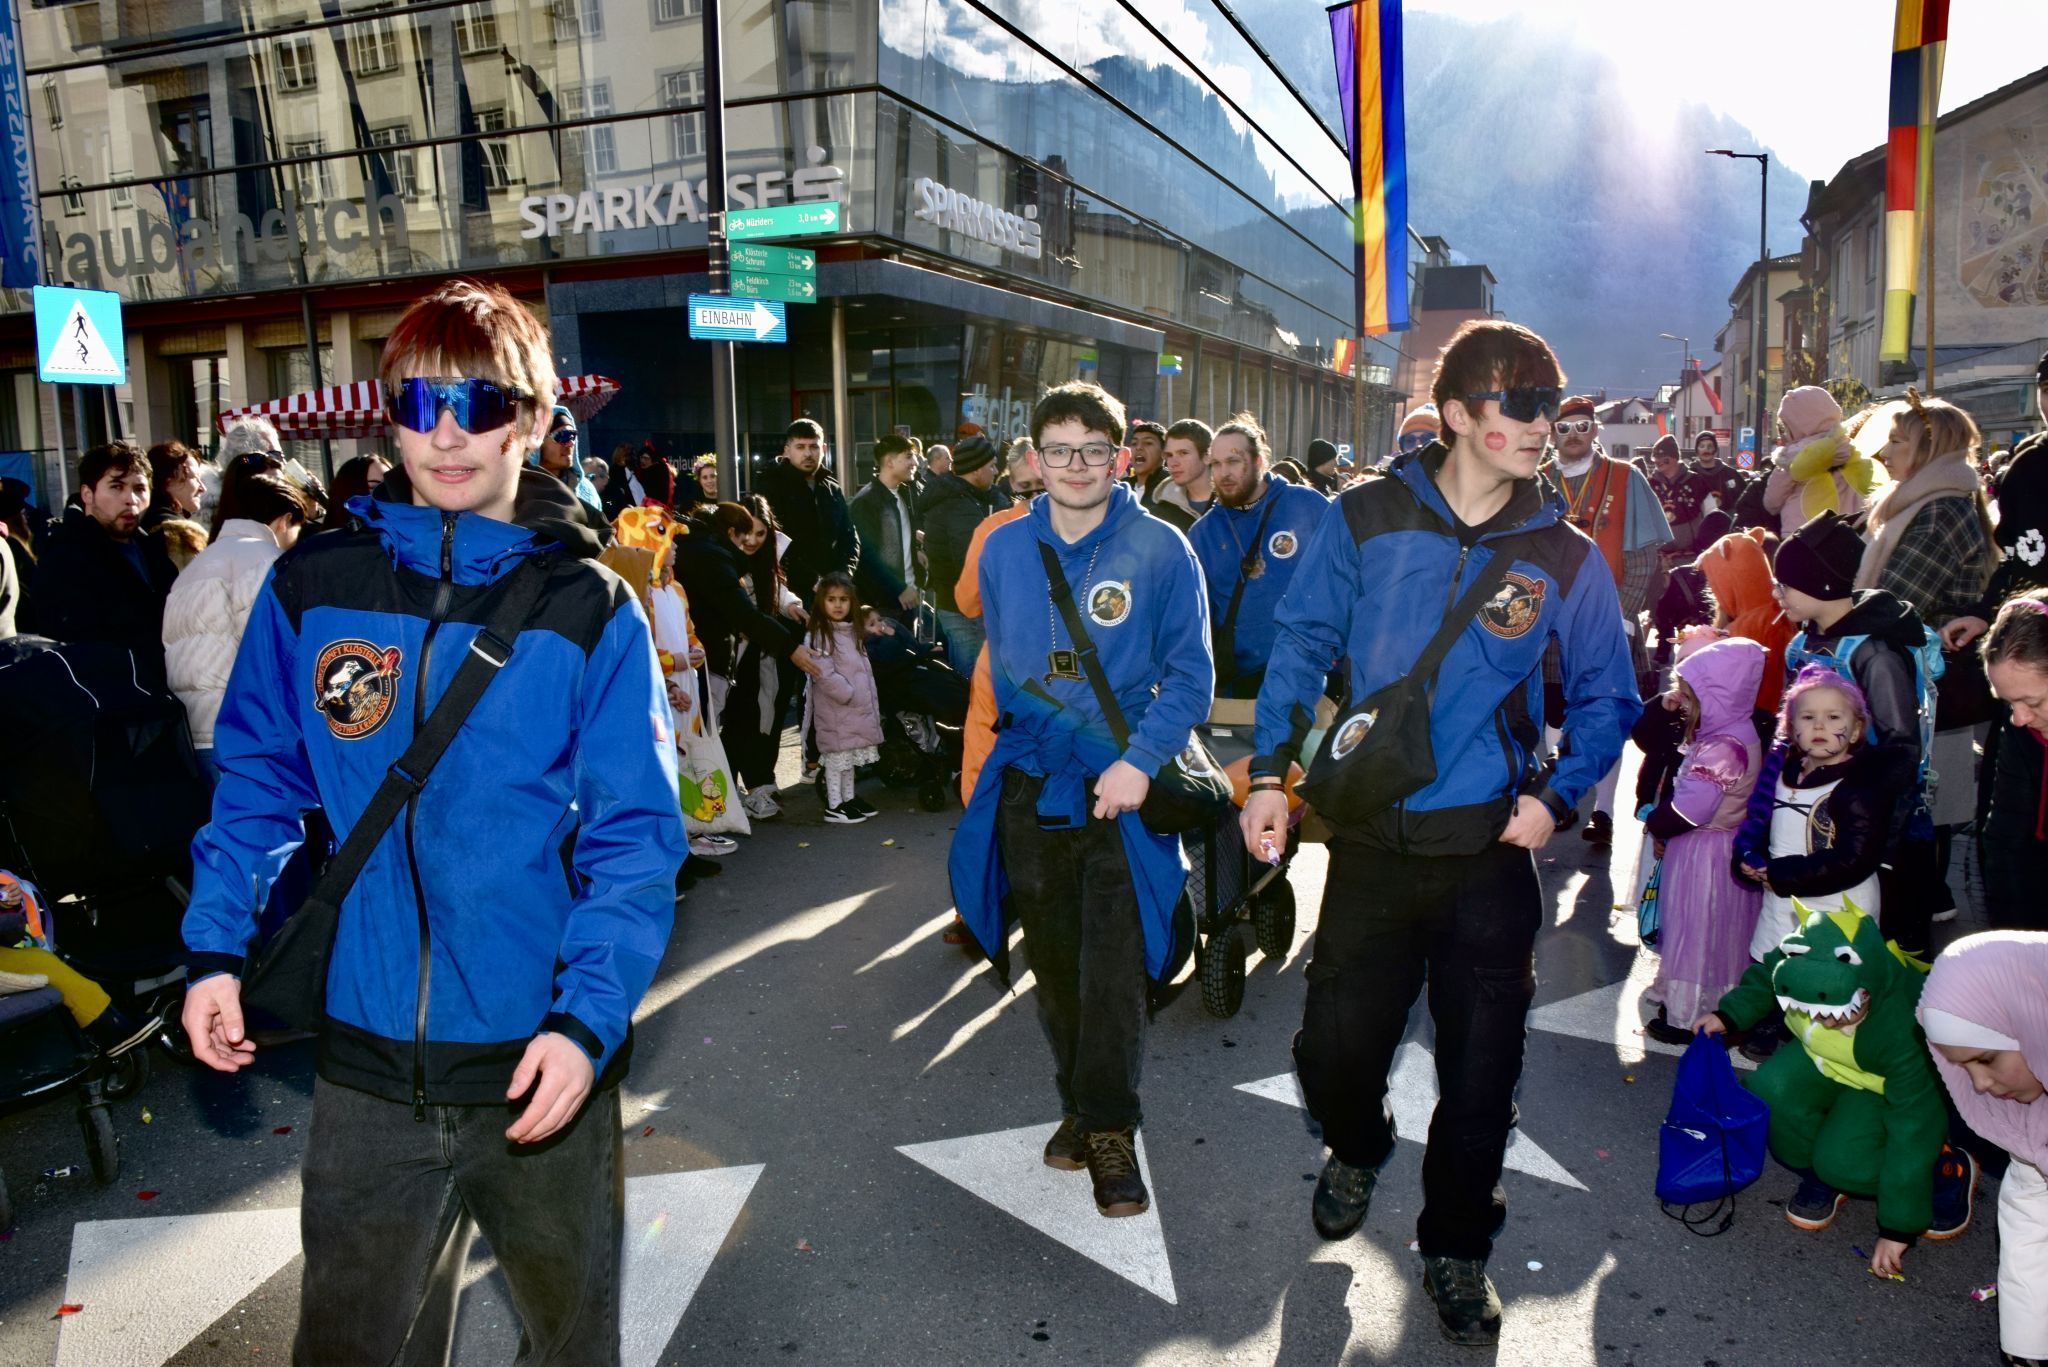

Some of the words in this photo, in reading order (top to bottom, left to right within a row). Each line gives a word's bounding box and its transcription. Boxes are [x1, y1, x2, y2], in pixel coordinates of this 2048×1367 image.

[746, 217, 774, 227] Nüziders
[798, 213, 809, 223] 3,0
[914, 177, 1024, 254] SPARKASSE
[40, 180, 408, 288] laubandich
[745, 256, 765, 266] Schruns
[746, 276, 769, 285] Feldkirch
[701, 310, 752, 326] EINBAHN
[1741, 427, 1755, 443] P
[1338, 444, 1350, 458] P
